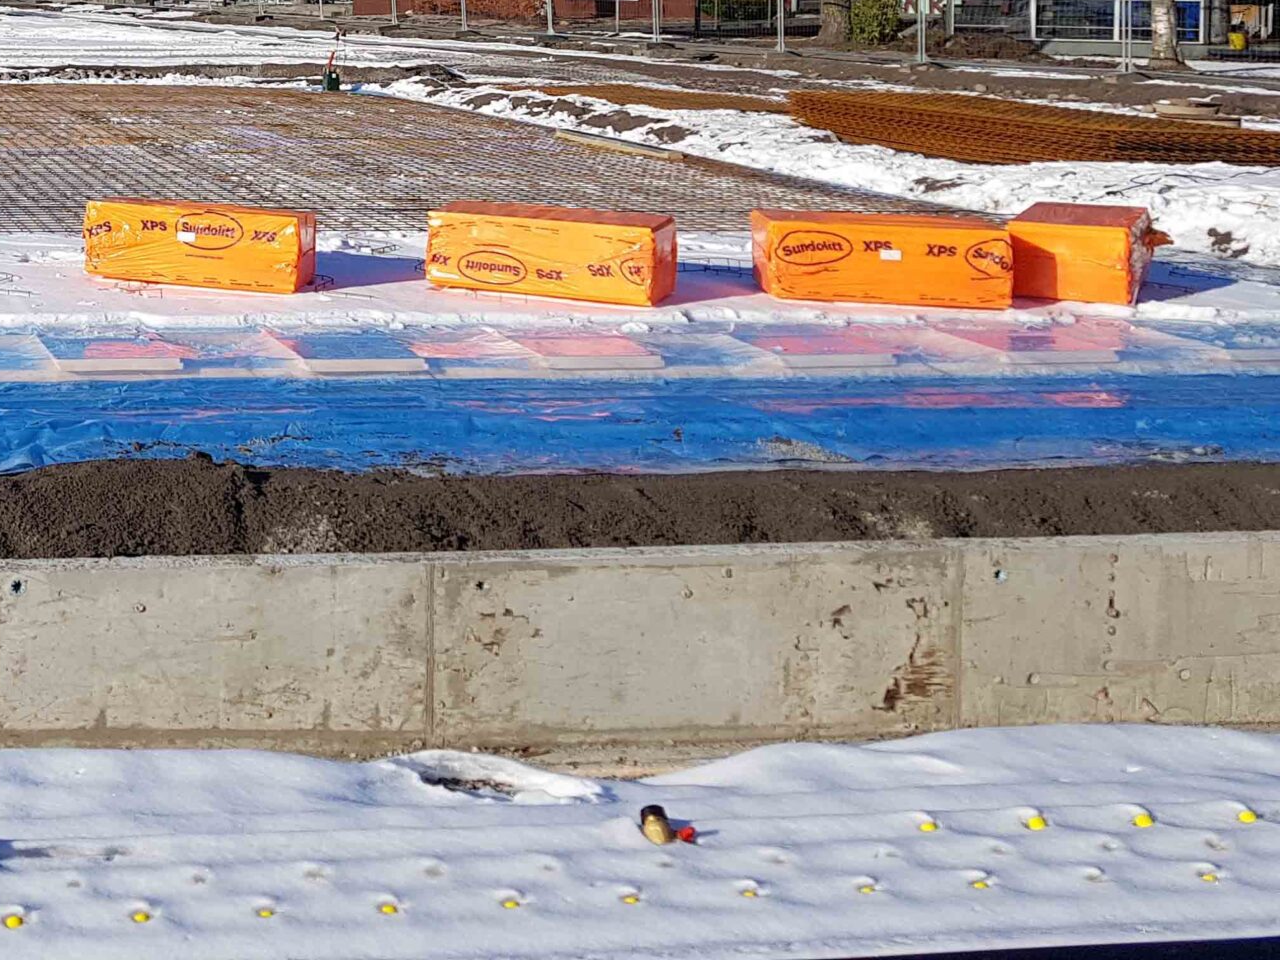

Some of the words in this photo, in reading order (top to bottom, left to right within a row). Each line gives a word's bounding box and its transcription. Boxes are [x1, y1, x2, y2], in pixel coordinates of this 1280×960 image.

[141, 220, 168, 231] XPS
[782, 241, 844, 256] Sundolitt
[863, 240, 893, 252] XPS
[926, 244, 958, 257] XPS
[466, 259, 521, 276] Sundolitt
[536, 268, 565, 280] XPS
[589, 264, 615, 278] XPS
